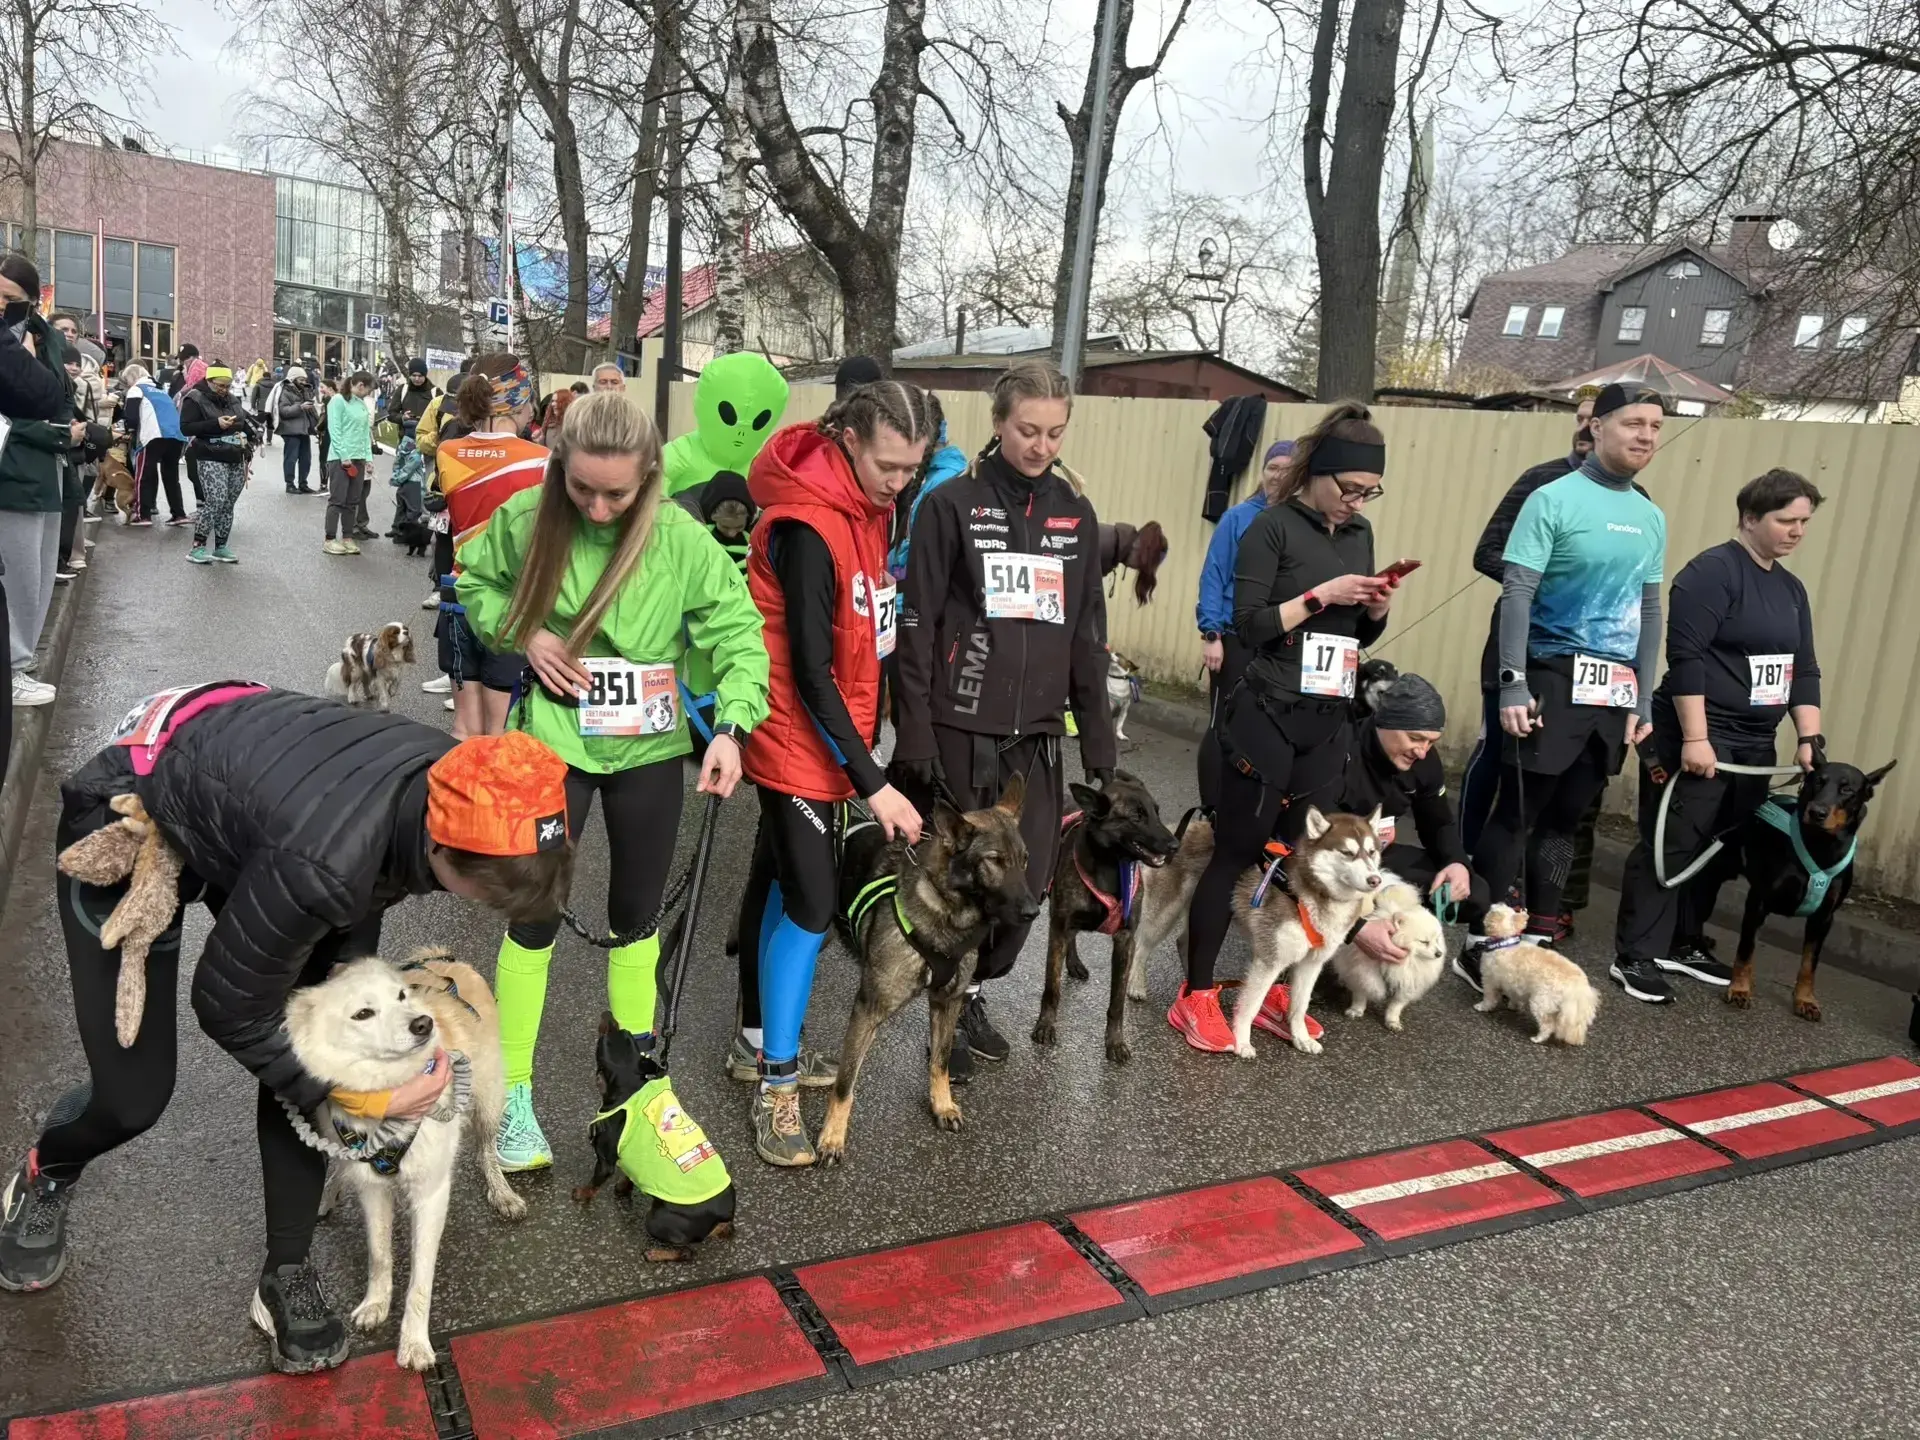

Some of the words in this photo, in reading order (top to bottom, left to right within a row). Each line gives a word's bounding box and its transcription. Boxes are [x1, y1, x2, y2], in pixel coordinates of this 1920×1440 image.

[467, 449, 506, 458] ЕВРАЗ
[991, 564, 1030, 594] 514
[1315, 644, 1336, 672] 17
[1578, 662, 1609, 686] 730
[1755, 664, 1782, 686] 787
[587, 671, 637, 706] 851
